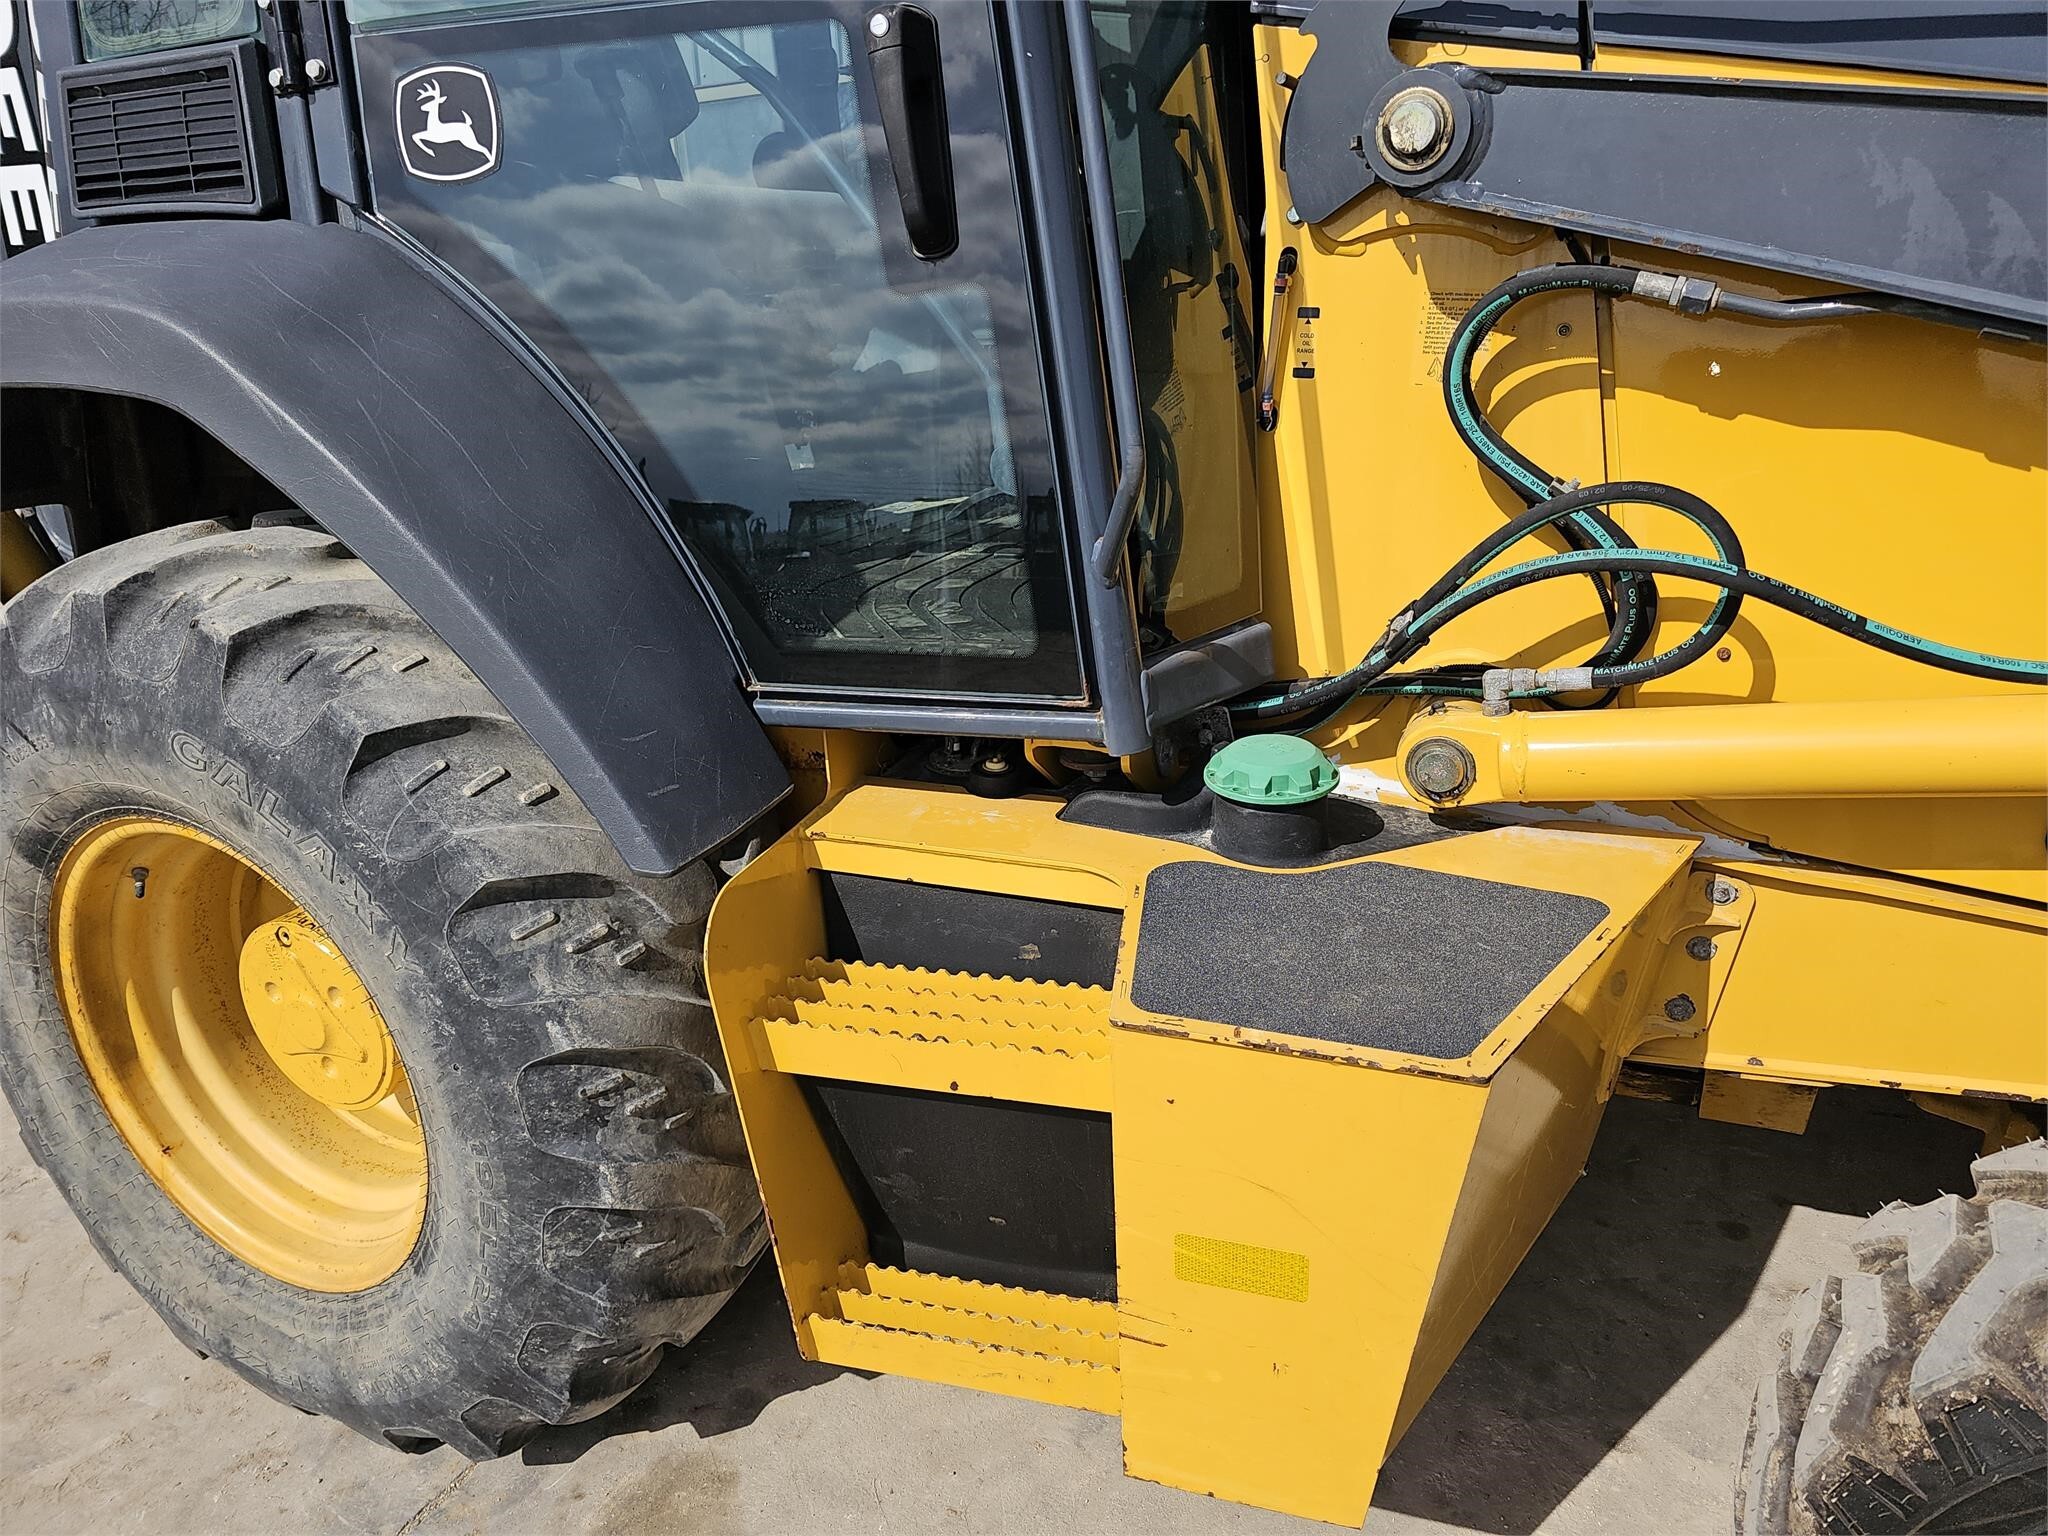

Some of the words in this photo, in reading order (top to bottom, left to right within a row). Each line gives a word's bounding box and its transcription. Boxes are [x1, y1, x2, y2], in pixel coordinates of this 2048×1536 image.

[1468, 299, 1505, 336] AEROQUIP
[1873, 623, 1922, 646] AEROQUIP
[170, 730, 424, 977] GALAXY
